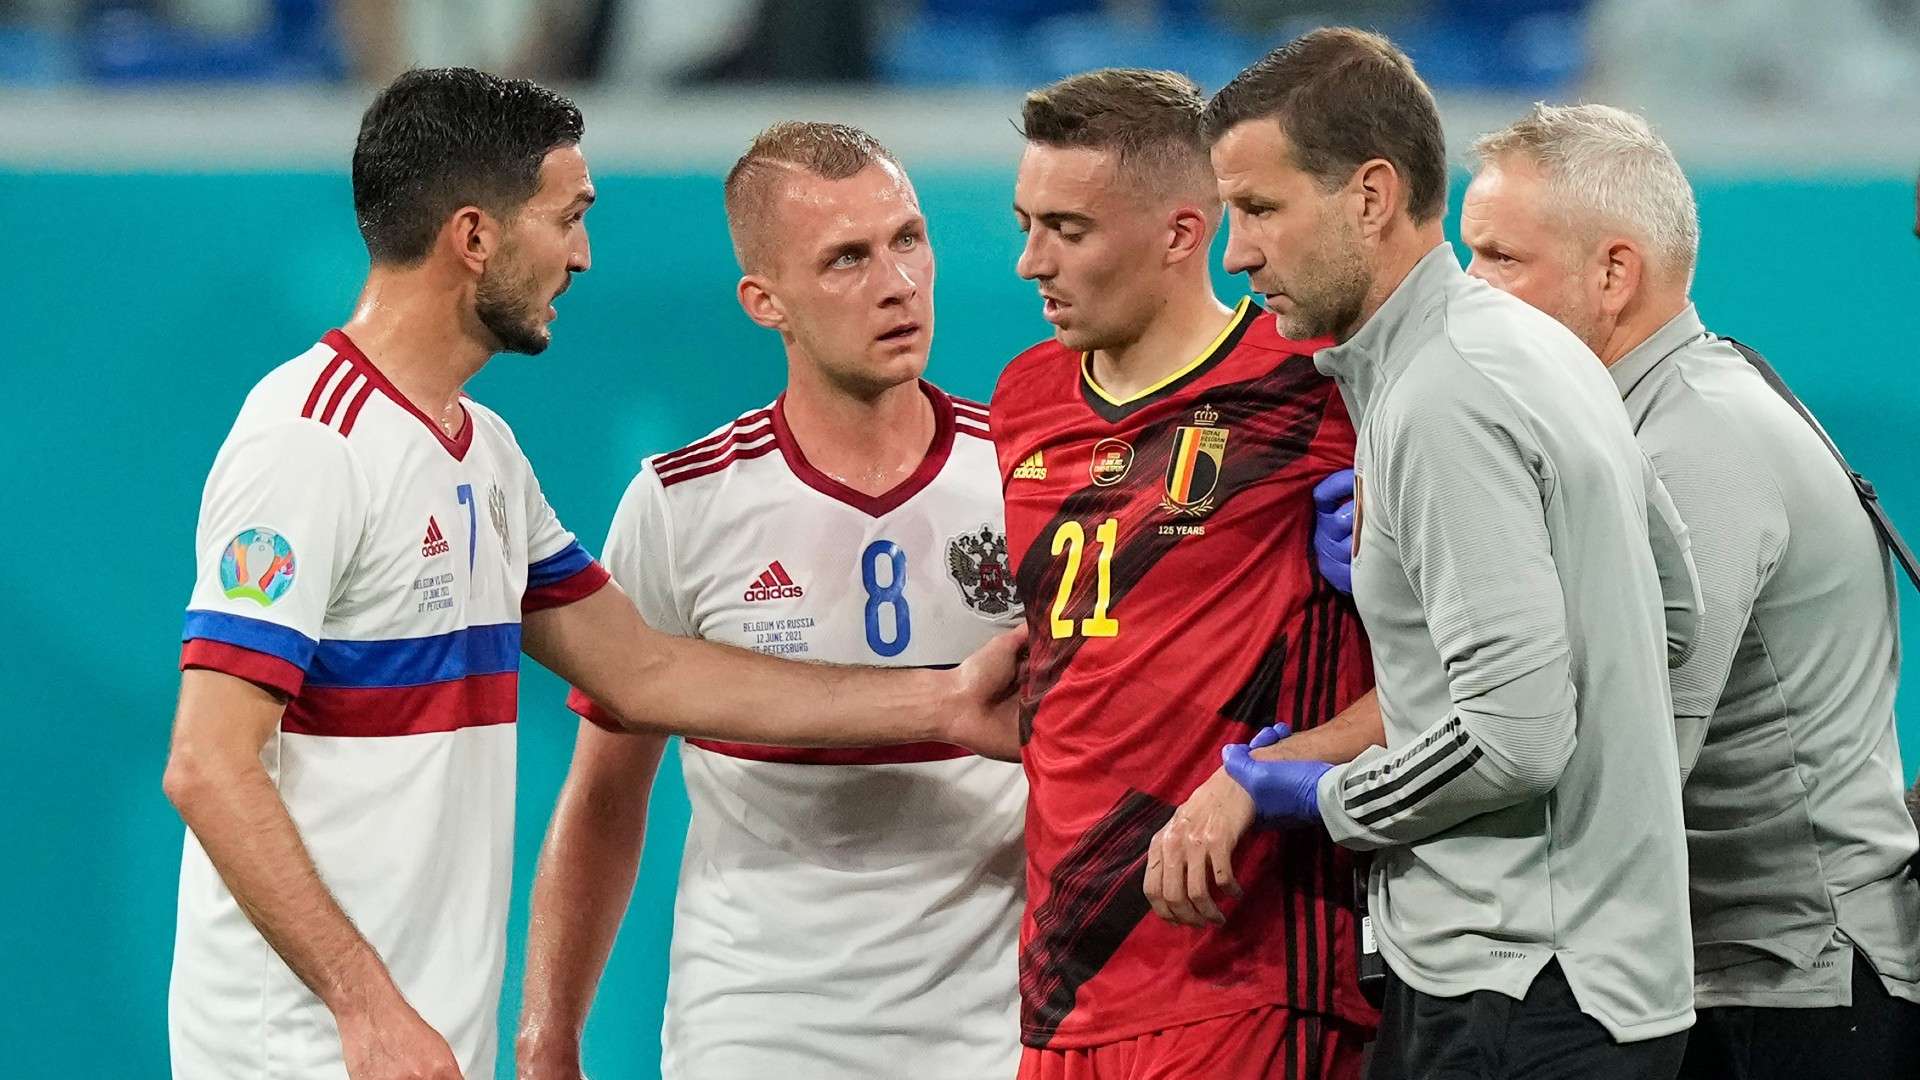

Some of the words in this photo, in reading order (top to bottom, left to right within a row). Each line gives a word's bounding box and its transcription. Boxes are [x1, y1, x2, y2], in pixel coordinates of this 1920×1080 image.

[1013, 465, 1047, 480] adidas
[1158, 525, 1174, 535] 125
[1176, 525, 1206, 536] YEARS
[457, 484, 476, 598] 7
[422, 542, 449, 557] adidas
[1051, 518, 1118, 639] 21
[744, 585, 803, 602] adidas
[861, 540, 910, 656] 8
[743, 621, 774, 632] BELGIUM
[776, 619, 786, 630] VS
[786, 617, 815, 629] RUSSIA
[757, 633, 764, 643] 12
[765, 632, 783, 643] JUNE
[785, 630, 802, 641] 2021
